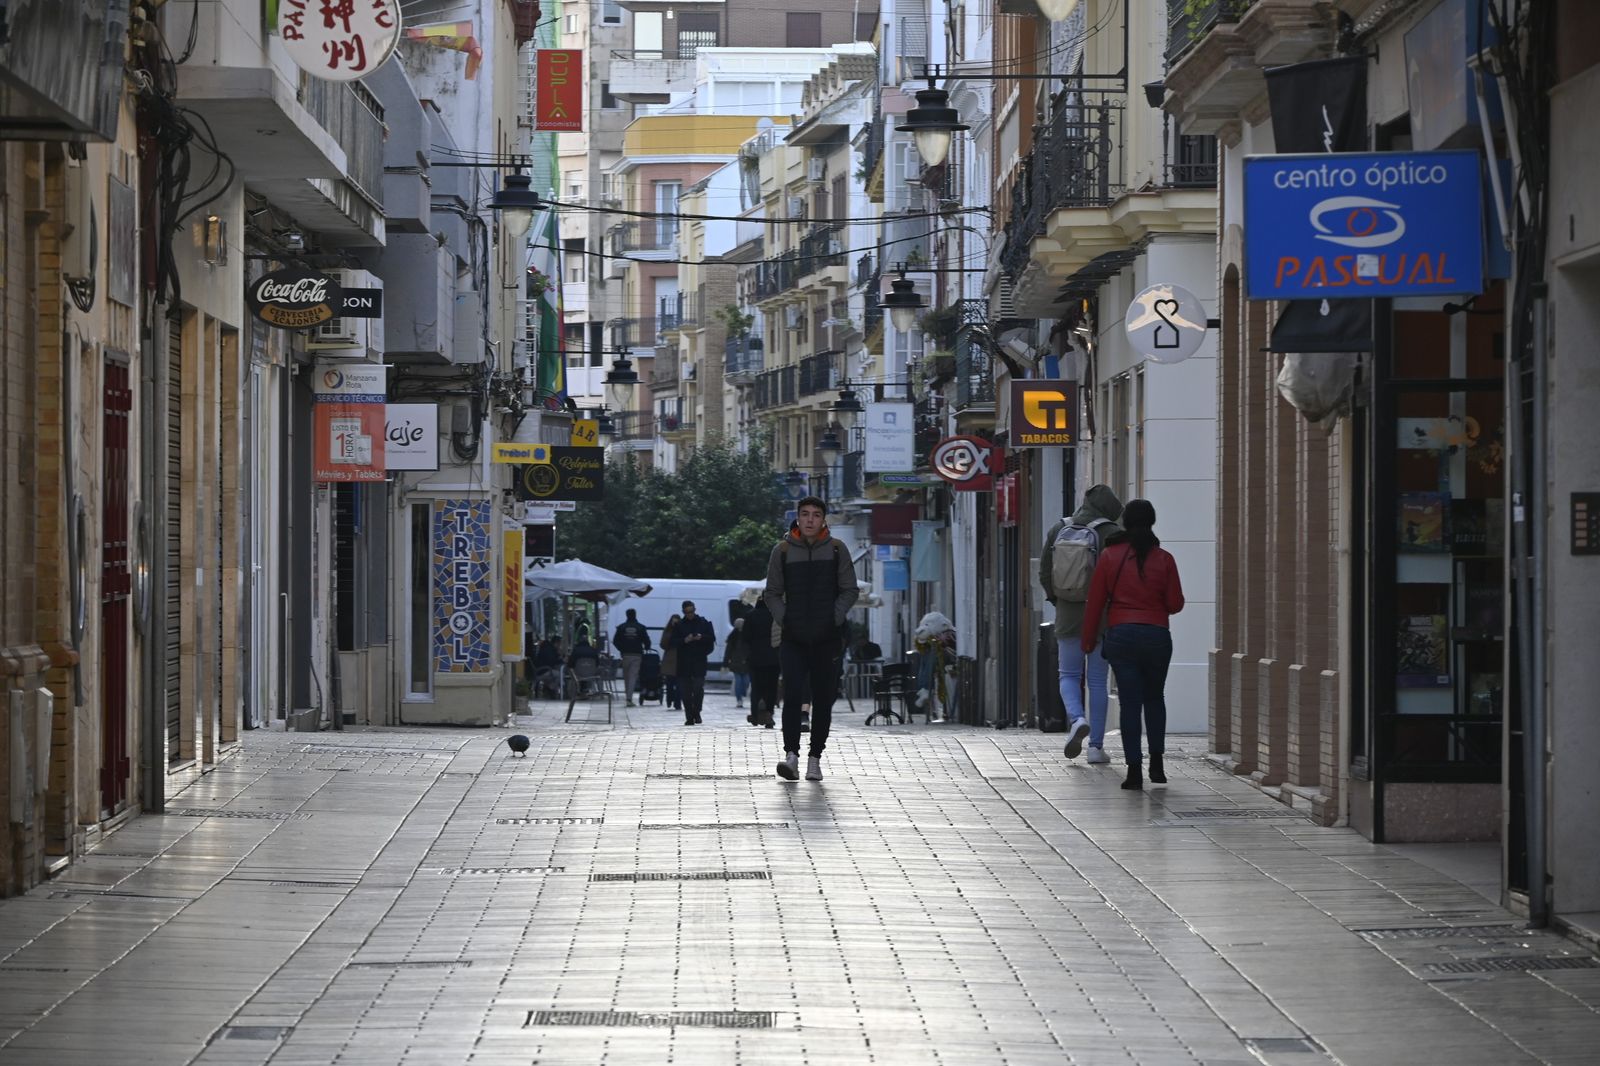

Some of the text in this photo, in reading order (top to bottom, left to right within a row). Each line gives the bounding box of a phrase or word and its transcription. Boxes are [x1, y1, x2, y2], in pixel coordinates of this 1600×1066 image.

[1274, 160, 1447, 191] centro óptico
[257, 278, 329, 303] Coca-Cola
[345, 374, 377, 382] Manzana
[317, 394, 350, 402] SERVICIO
[335, 432, 345, 457] 1
[345, 432, 354, 458] HORA
[1020, 433, 1070, 444] TABACOS
[498, 449, 530, 458] Trebol
[346, 472, 352, 480] y
[354, 470, 383, 478] Tablets
[451, 509, 473, 662] TREBOL
[506, 563, 519, 623] DHL
